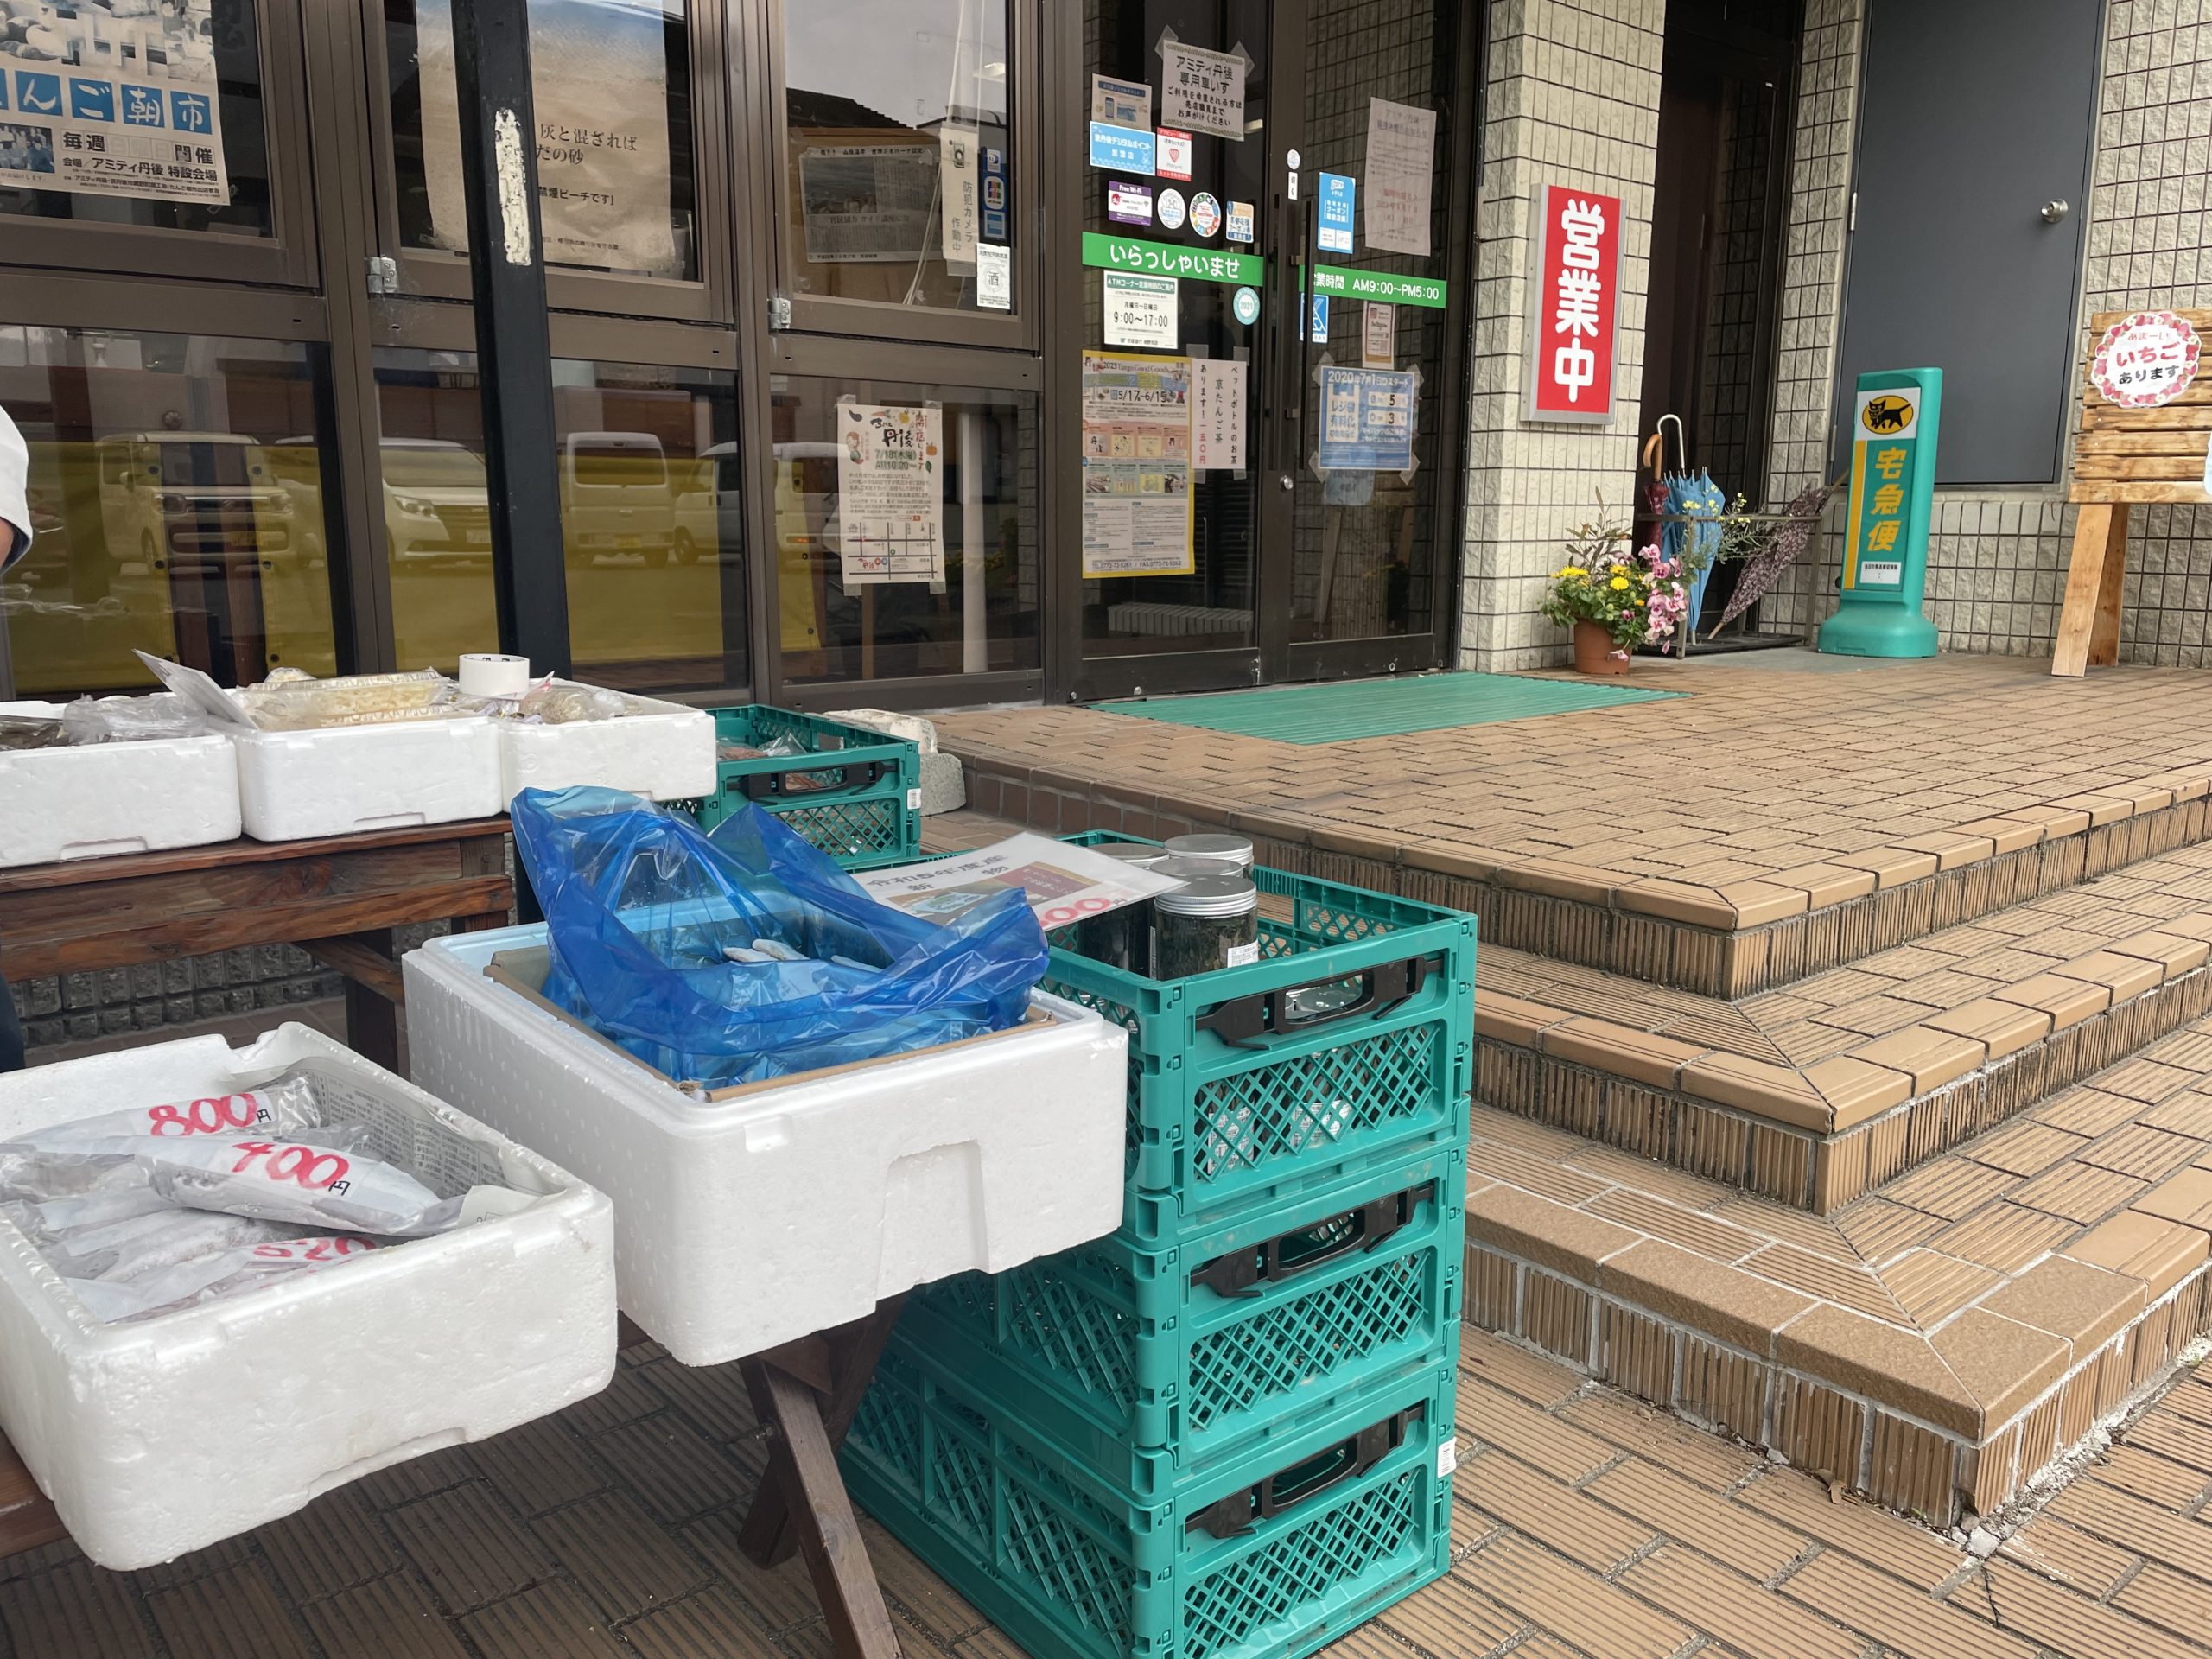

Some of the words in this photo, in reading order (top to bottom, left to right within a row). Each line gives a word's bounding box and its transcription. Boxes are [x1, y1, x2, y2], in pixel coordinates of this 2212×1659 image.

[1176, 56, 1234, 80] アミティ丹後
[1179, 72, 1229, 94] 専用車いす
[0, 76, 206, 131] んご朝市
[1178, 110, 1230, 126] お声がけください
[62, 131, 106, 152] 毎週
[175, 144, 214, 165] 開催
[167, 164, 218, 181] 特設会場
[963, 180, 974, 243] 防犯カメラ
[951, 217, 962, 253] 作動中
[1109, 244, 1241, 279] いらっしゃいませ
[1554, 198, 1605, 404] 営業中
[1103, 361, 1117, 371] 2023
[2116, 340, 2181, 368] いちご
[2119, 364, 2180, 385] あります
[1215, 378, 1224, 444] 京たんご茶
[881, 429, 914, 448] 丹後
[1866, 447, 1907, 552] 宅急便
[866, 855, 1009, 887] 令和5年度産
